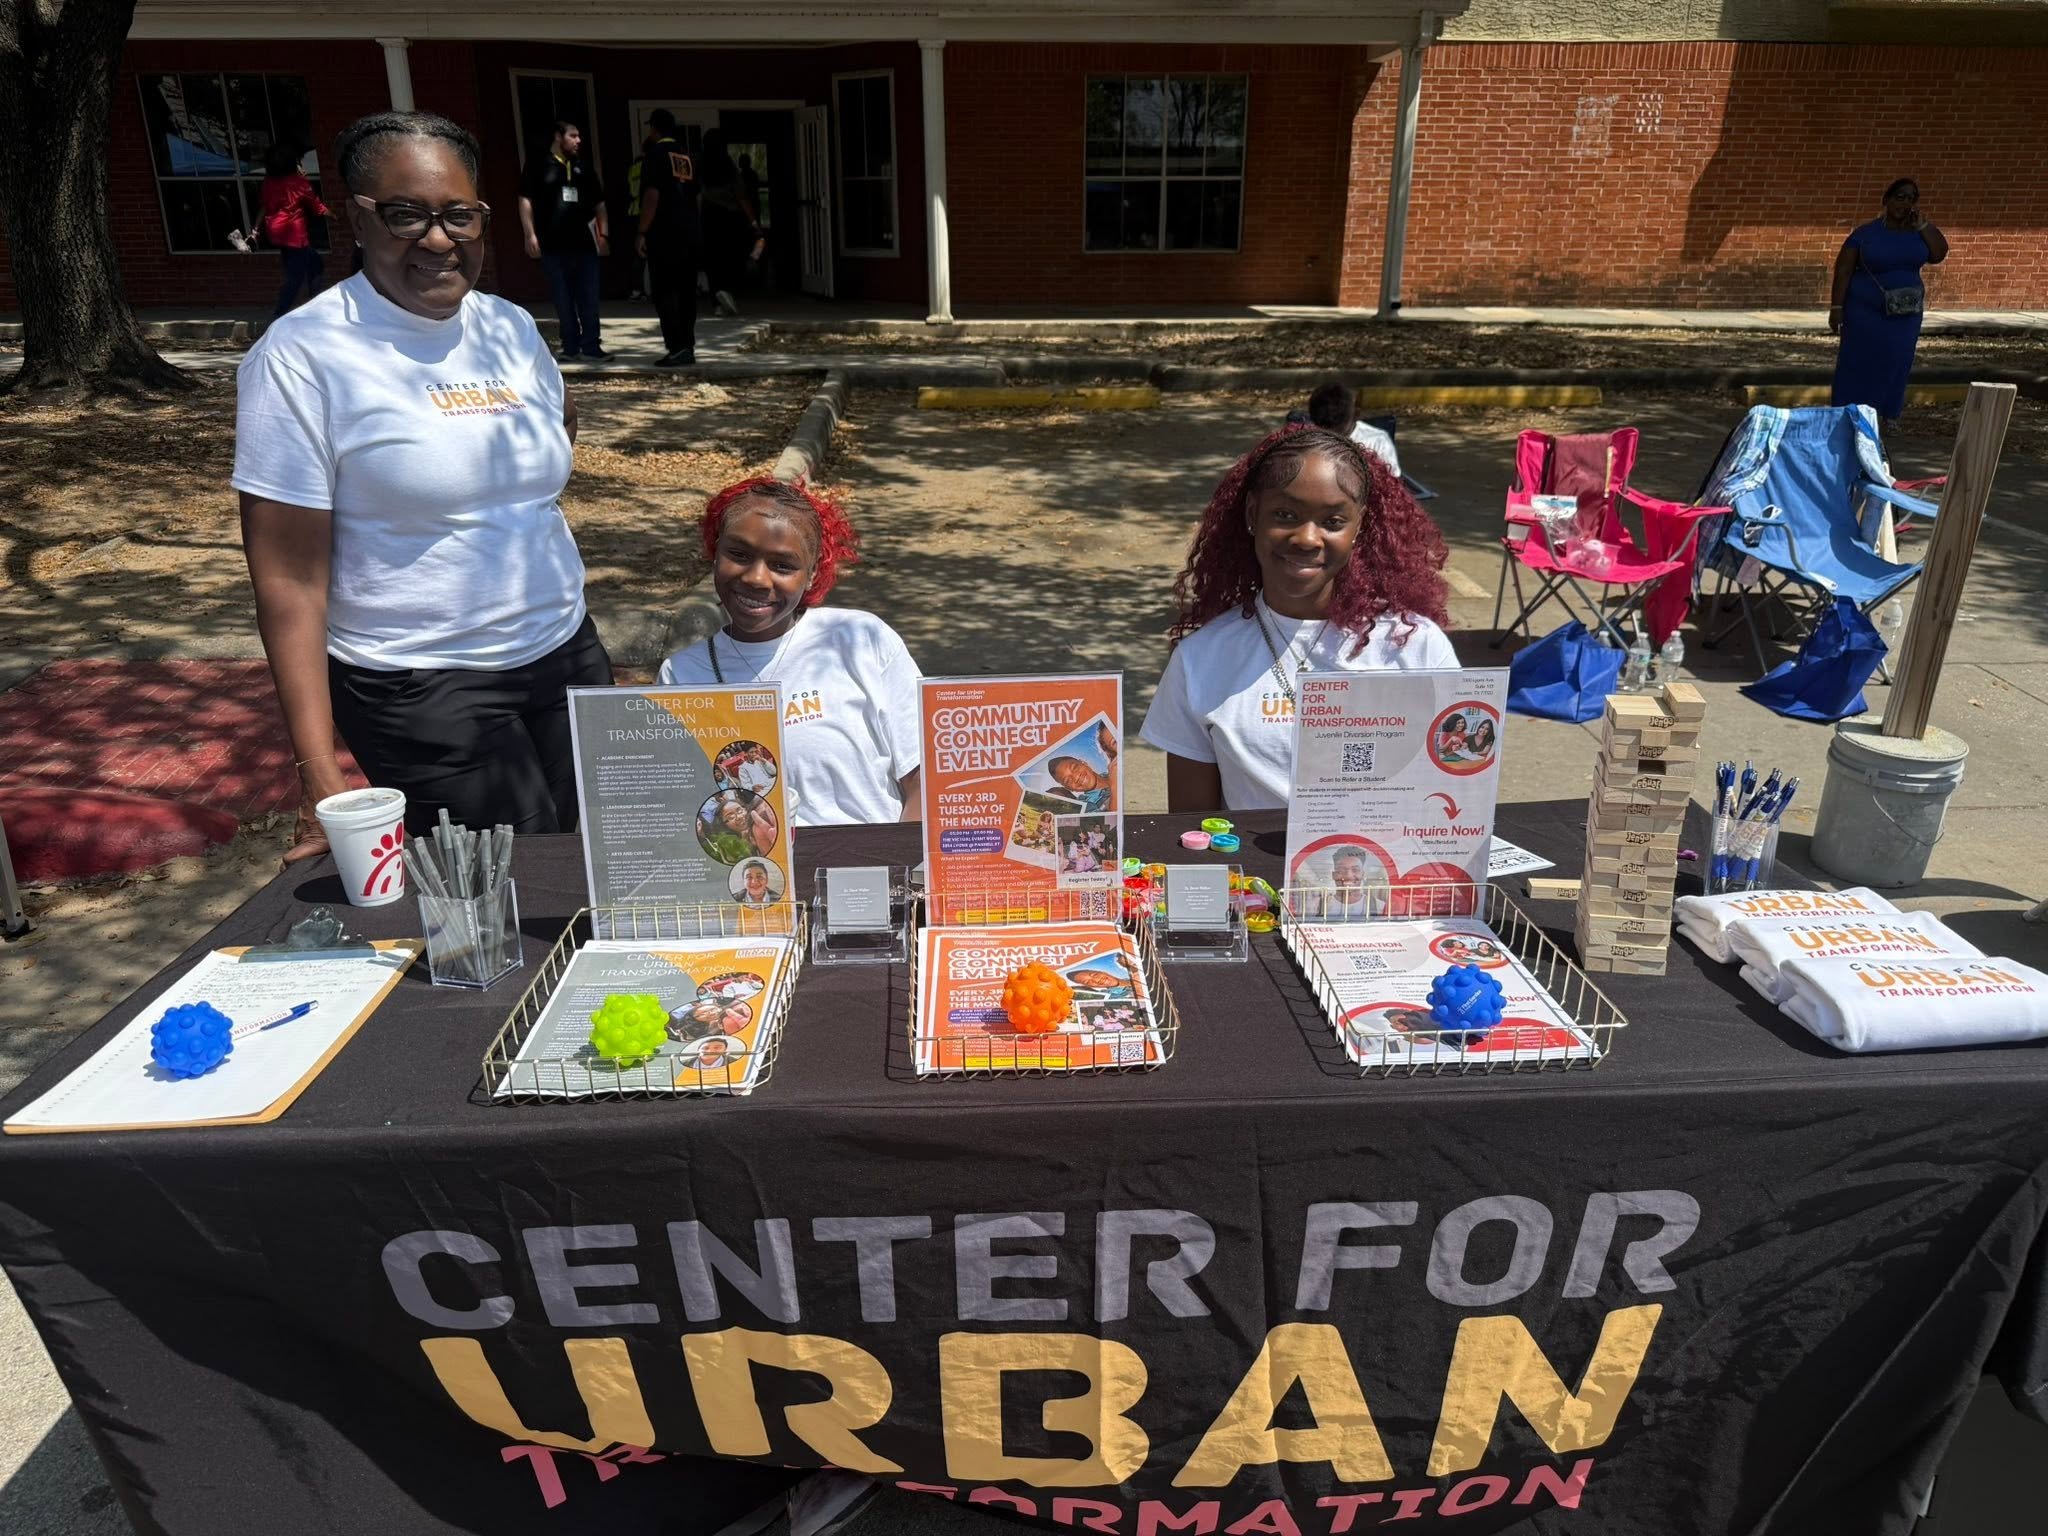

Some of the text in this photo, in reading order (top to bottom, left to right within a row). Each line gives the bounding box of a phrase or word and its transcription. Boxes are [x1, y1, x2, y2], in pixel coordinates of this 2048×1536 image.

[425, 380, 507, 392] CENTER FOR
[430, 387, 521, 410] URBAN
[441, 403, 527, 417] TRANSFORMATION
[1303, 681, 1349, 692] CENTER
[792, 690, 819, 700] FOR
[1302, 694, 1326, 703] FOR
[625, 698, 715, 711] CENTER FOR
[736, 698, 773, 707] URBAN
[933, 700, 1082, 730] COMMUNITY
[1301, 706, 1341, 715] URBAN
[646, 713, 697, 725] URBAN
[1300, 717, 1406, 728] TRANSFORMATION
[1649, 716, 1675, 728] Jenga
[606, 726, 741, 741] TRANSFORMATION
[935, 725, 1049, 749] CONNECT
[1375, 731, 1405, 739] Program
[1638, 746, 1664, 758] Jenga
[937, 748, 1010, 771] EVENT
[1637, 777, 1662, 790] Jenga
[938, 792, 997, 804] EVERY 3RD
[939, 804, 1005, 815] TUESDAY OF
[939, 816, 1002, 827] THE MONTH
[1403, 825, 1485, 838] Inquire Now!
[1625, 832, 1650, 844] Jenga
[1622, 863, 1646, 875] Jenga
[1623, 890, 1648, 902] Jenga
[1728, 895, 1869, 913] URBAN
[1744, 910, 1876, 918] TRANSFORMATION
[1622, 920, 1645, 932] Jenga
[1782, 922, 1920, 935] CENTER FOR
[1787, 928, 1939, 950] URBAN
[627, 952, 717, 961] CENTER FOR
[949, 942, 1097, 960] COMMUNITY
[1611, 945, 1634, 957] Jenga
[1805, 943, 1950, 959] TRANSFORMATION
[643, 960, 694, 968] URBAN
[949, 955, 1065, 969] CONNECT
[600, 966, 736, 977] TRANSFORMATION
[1953, 964, 1999, 974] FOR
[1856, 969, 2025, 988] URBAN
[1877, 984, 2036, 998] TRANSFORMATION
[381, 1189, 1701, 1330] CENTER FOR
[419, 1303, 1663, 1488] URBAN
